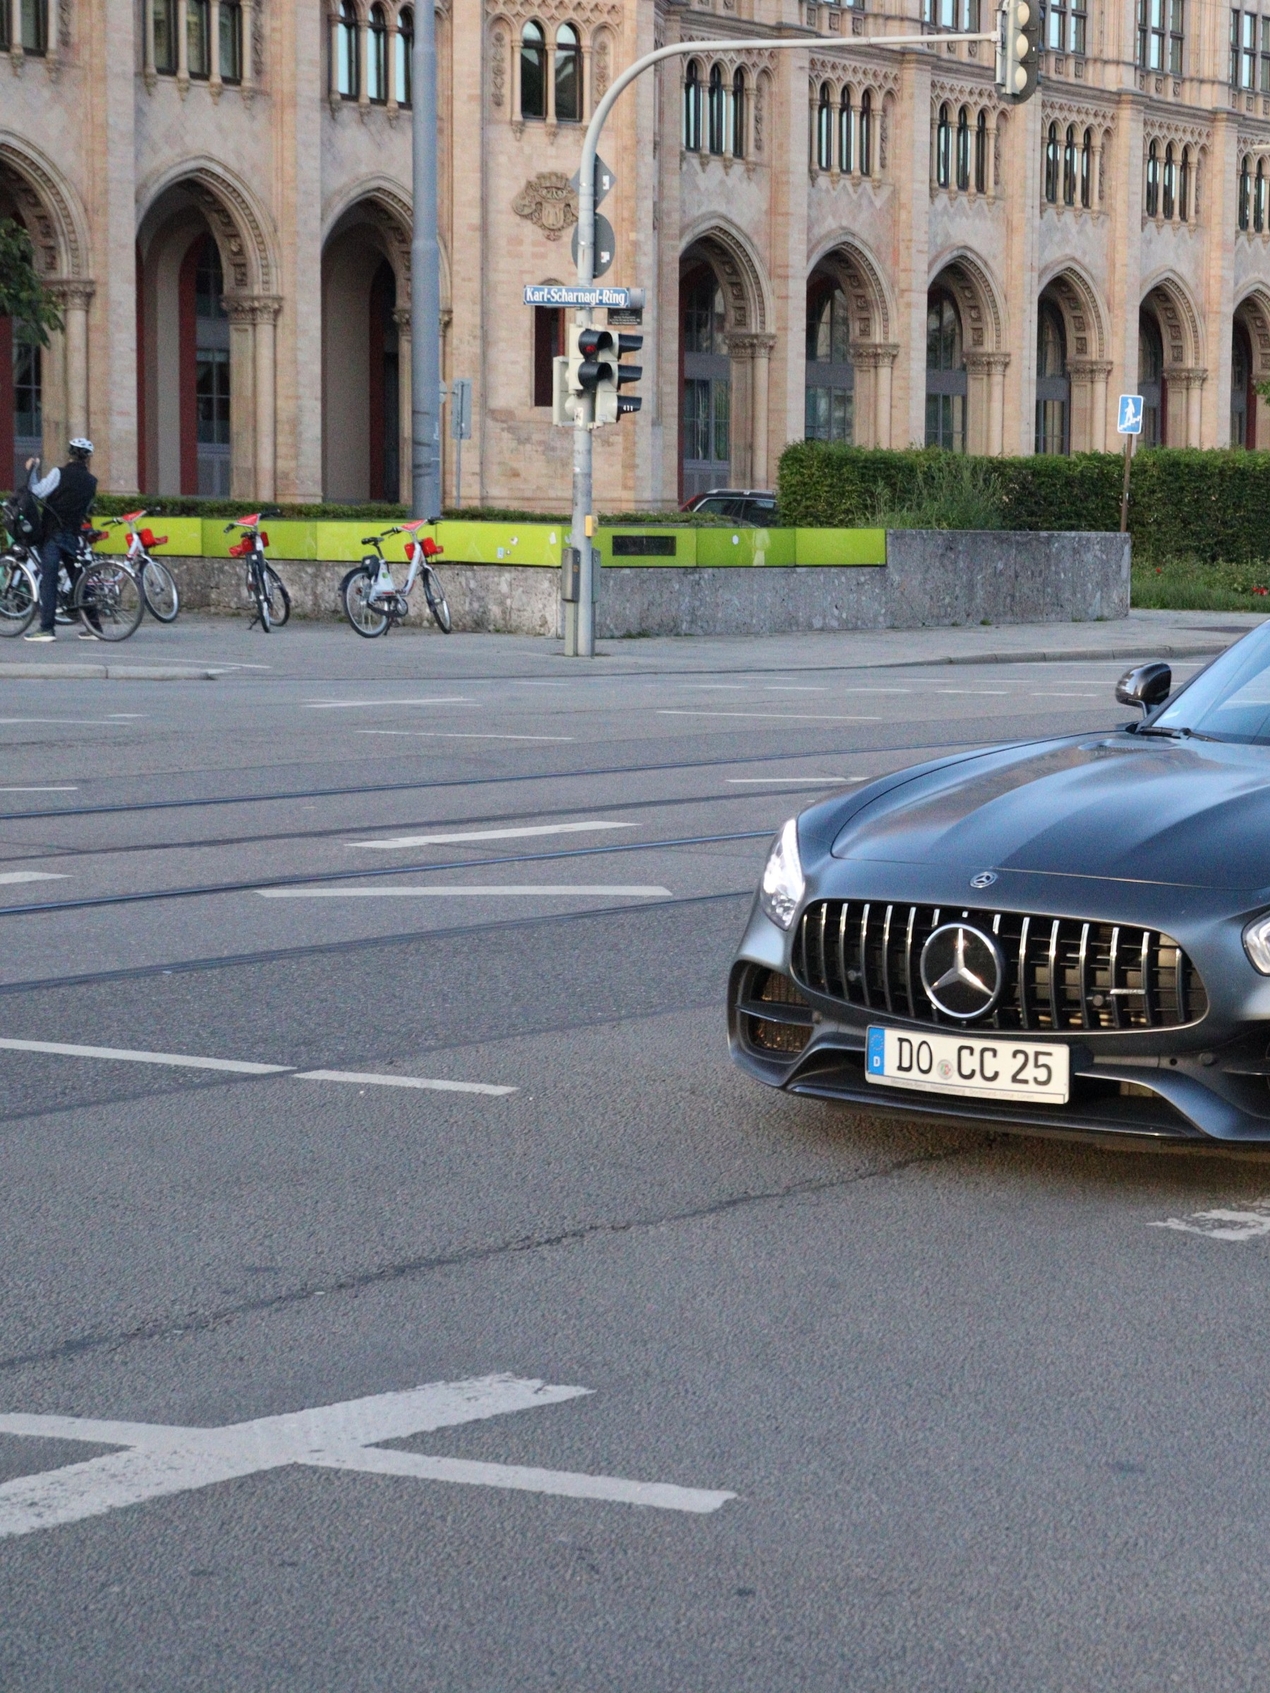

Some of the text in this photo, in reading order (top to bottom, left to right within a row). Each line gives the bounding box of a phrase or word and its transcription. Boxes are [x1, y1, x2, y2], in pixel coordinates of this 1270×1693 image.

[526, 288, 625, 306] Karl-Scharnagl-Ring
[873, 1056, 880, 1067] D
[897, 1037, 1053, 1086] DO CC 25
